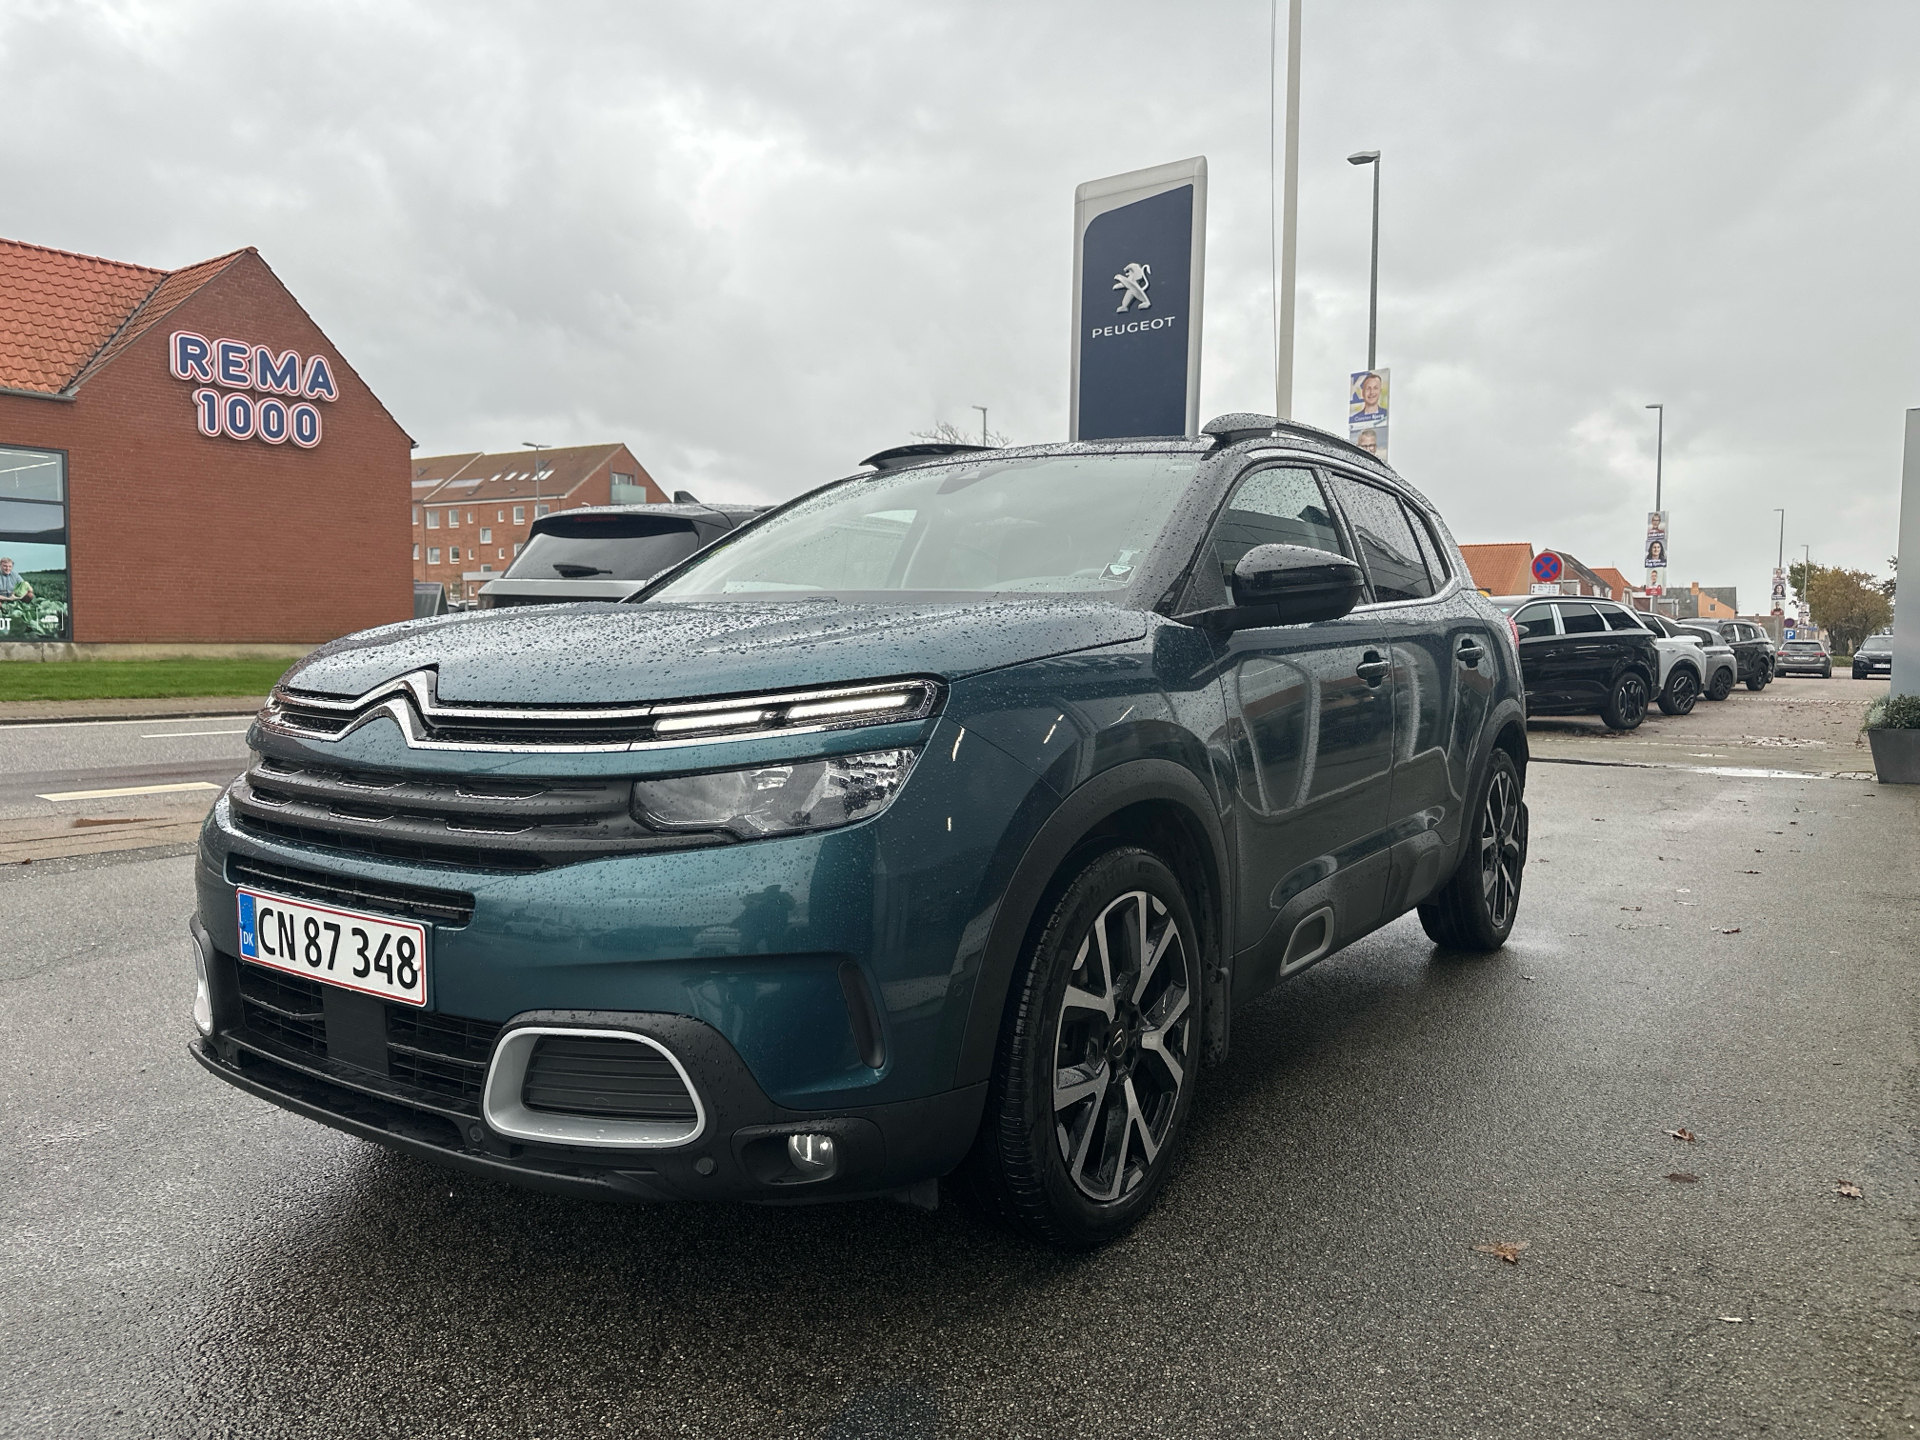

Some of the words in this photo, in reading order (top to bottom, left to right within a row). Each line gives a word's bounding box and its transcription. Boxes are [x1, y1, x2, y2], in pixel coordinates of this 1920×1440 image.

[1092, 316, 1176, 339] PEUGEOT
[173, 333, 337, 401] REMA
[195, 389, 322, 447] 1000
[243, 931, 254, 947] DK
[258, 907, 297, 961] CN
[304, 916, 341, 970] 87
[352, 927, 418, 990] 348
